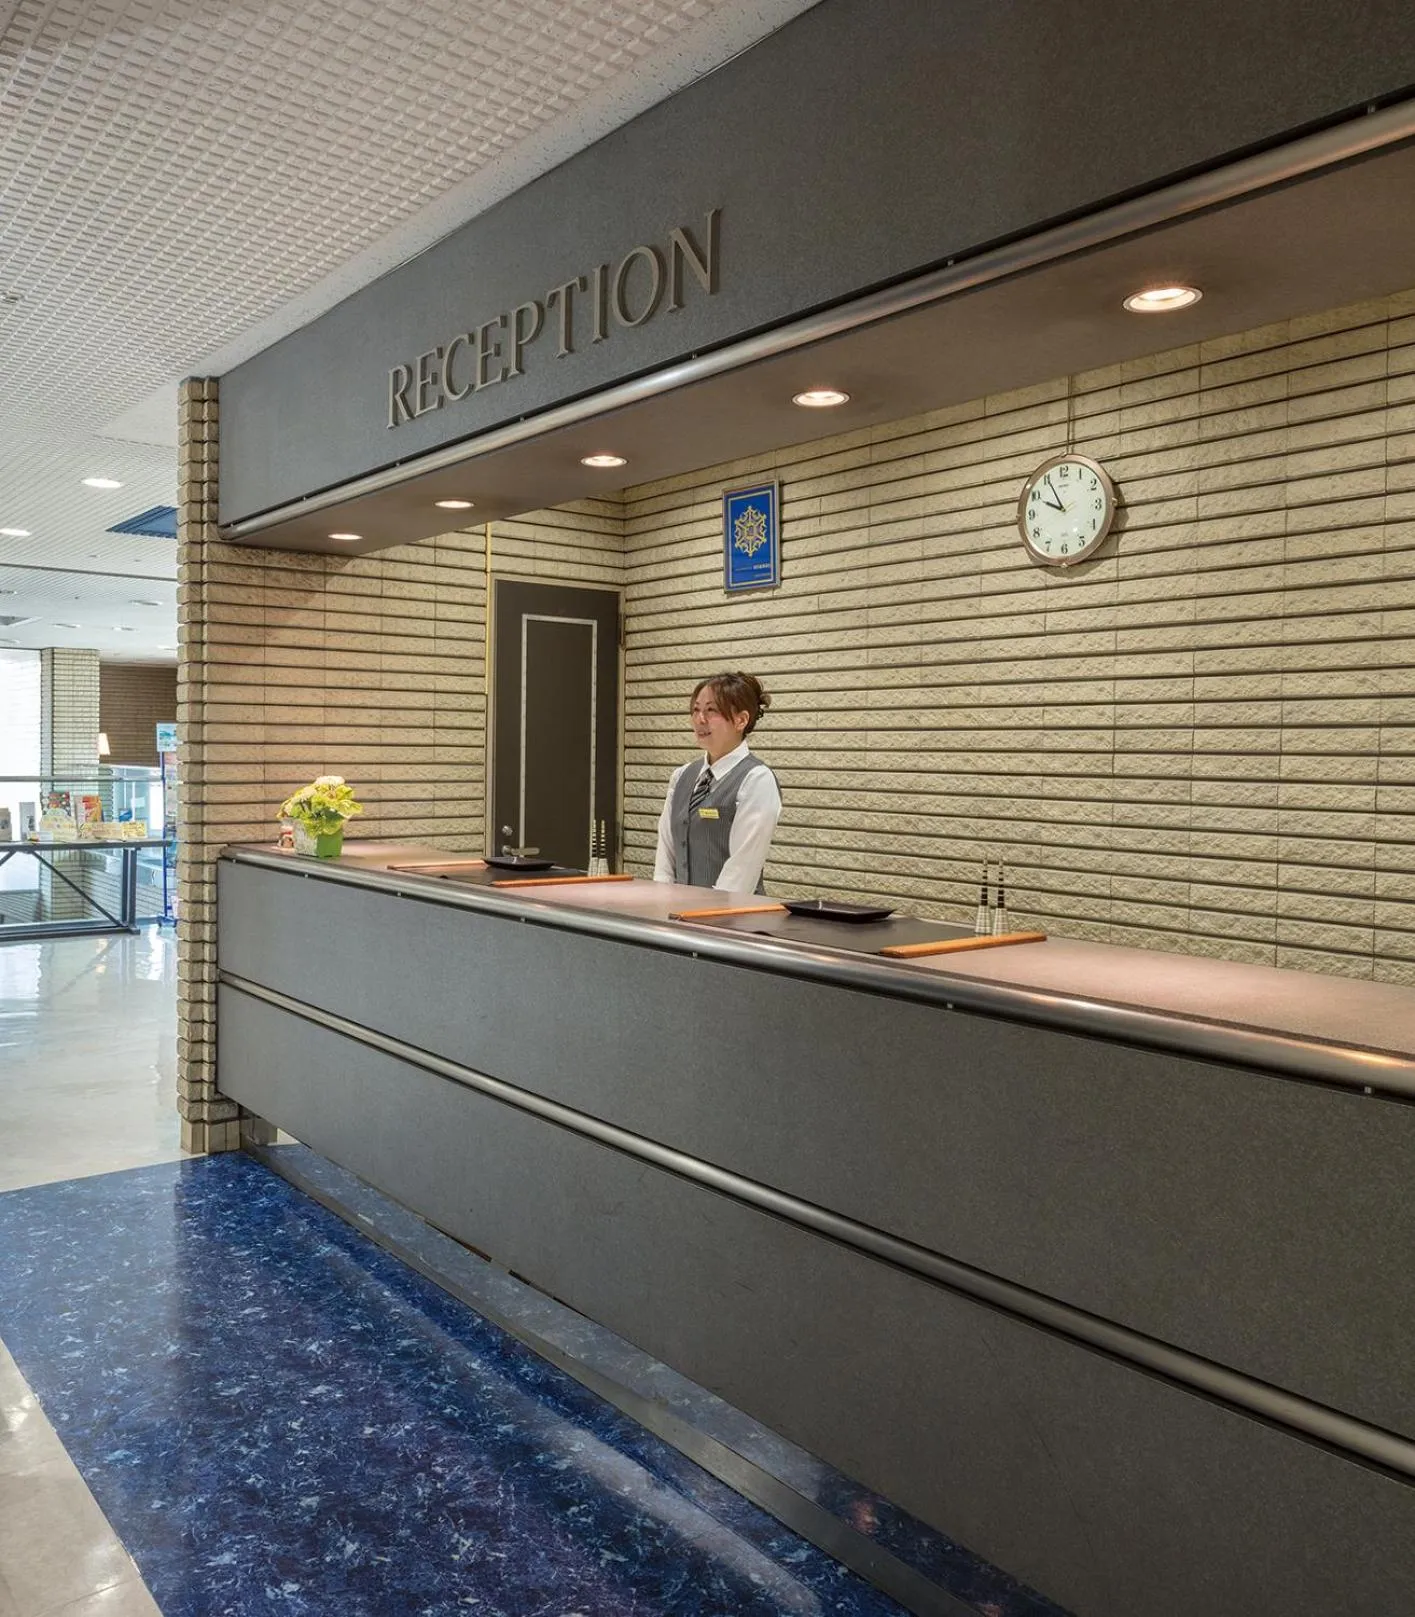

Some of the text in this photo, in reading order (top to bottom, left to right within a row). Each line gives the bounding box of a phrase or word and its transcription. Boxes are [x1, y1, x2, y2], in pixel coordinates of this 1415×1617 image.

[385, 207, 724, 430] RECEPTION
[1059, 465, 1069, 477] 12
[1078, 468, 1083, 480] 1
[1090, 478, 1097, 491] 2
[1031, 490, 1041, 501] 10
[1094, 498, 1102, 510] 3
[1028, 510, 1036, 520] 9
[1033, 527, 1040, 538] 8
[1045, 541, 1051, 552] 7
[1078, 535, 1085, 547] 5
[1061, 543, 1068, 554] 6
